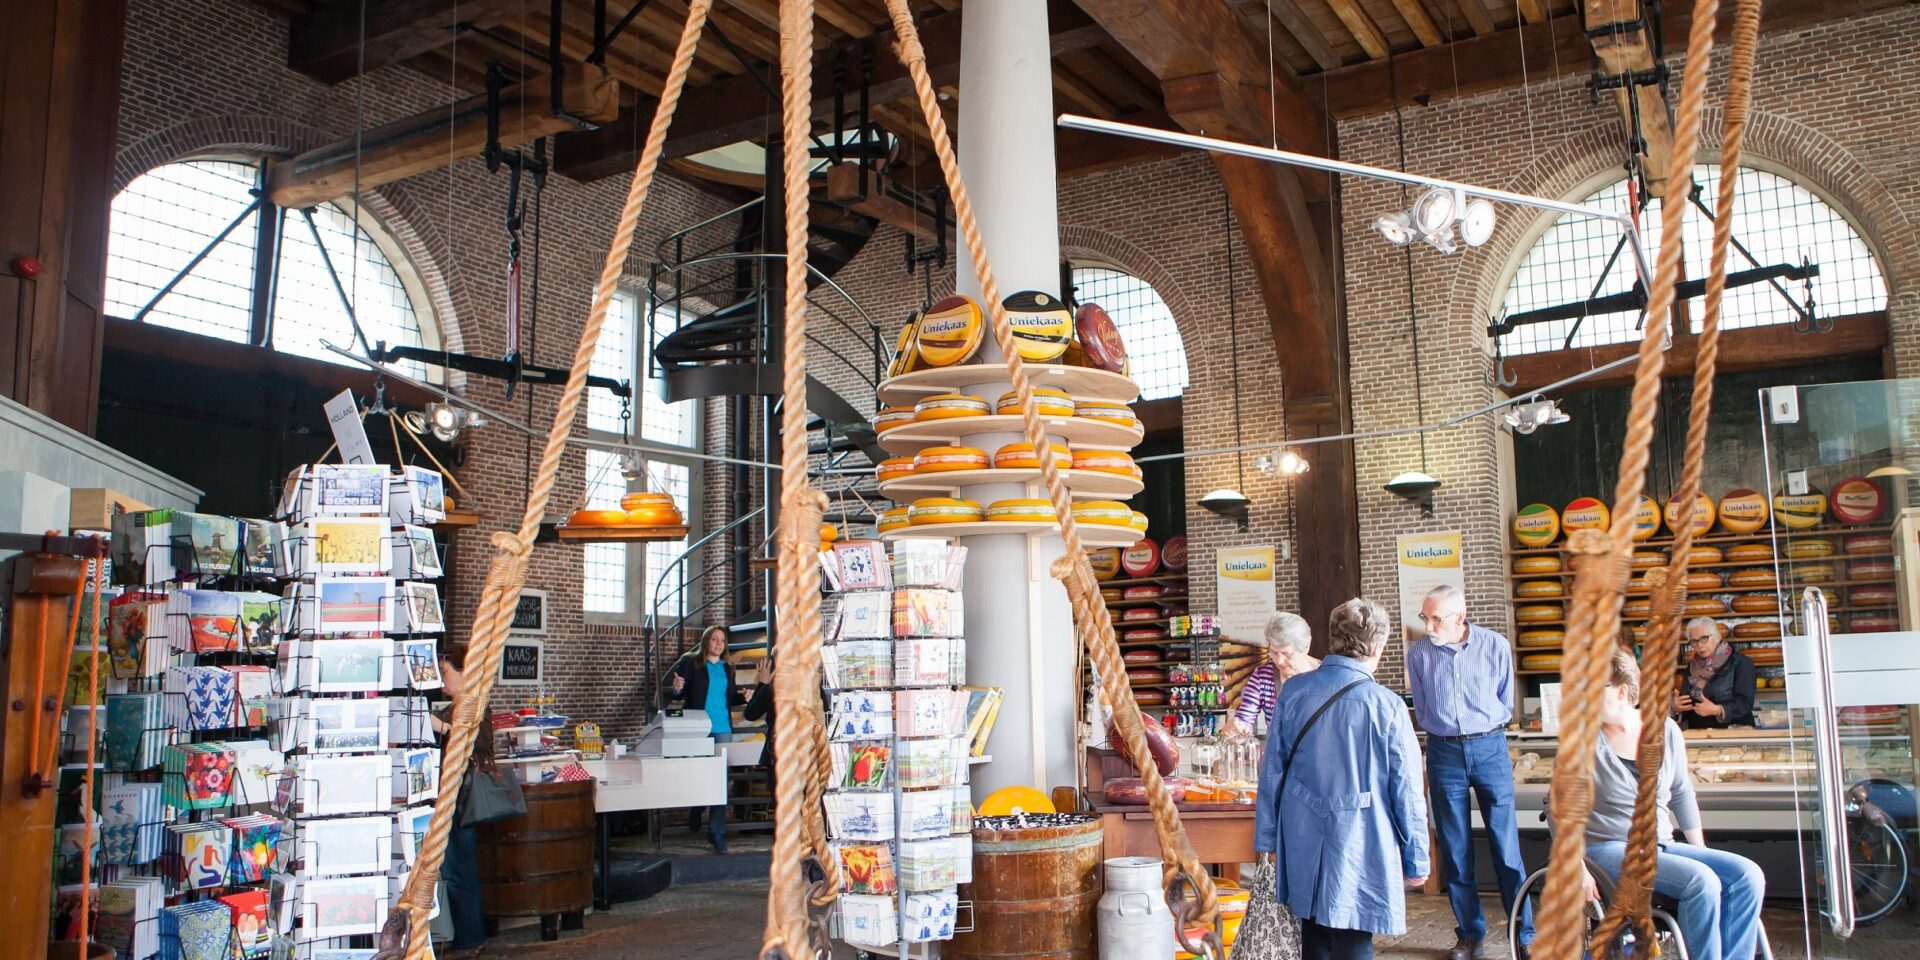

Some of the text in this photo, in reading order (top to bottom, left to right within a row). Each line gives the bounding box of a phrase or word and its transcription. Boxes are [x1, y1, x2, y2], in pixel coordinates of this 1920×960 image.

[1008, 316, 1064, 326] Uniekaas
[923, 321, 967, 334] Uniekaas
[331, 405, 354, 423] HOLLAND
[1725, 503, 1762, 512] Uniekaas
[1782, 498, 1819, 507] Uniekaas
[1518, 519, 1552, 528] Uniekaas
[1567, 515, 1601, 523] Uniekaas
[1406, 547, 1454, 559] Uniekaas
[1224, 560, 1267, 571] Uniekaas
[508, 648, 531, 661] KAAS
